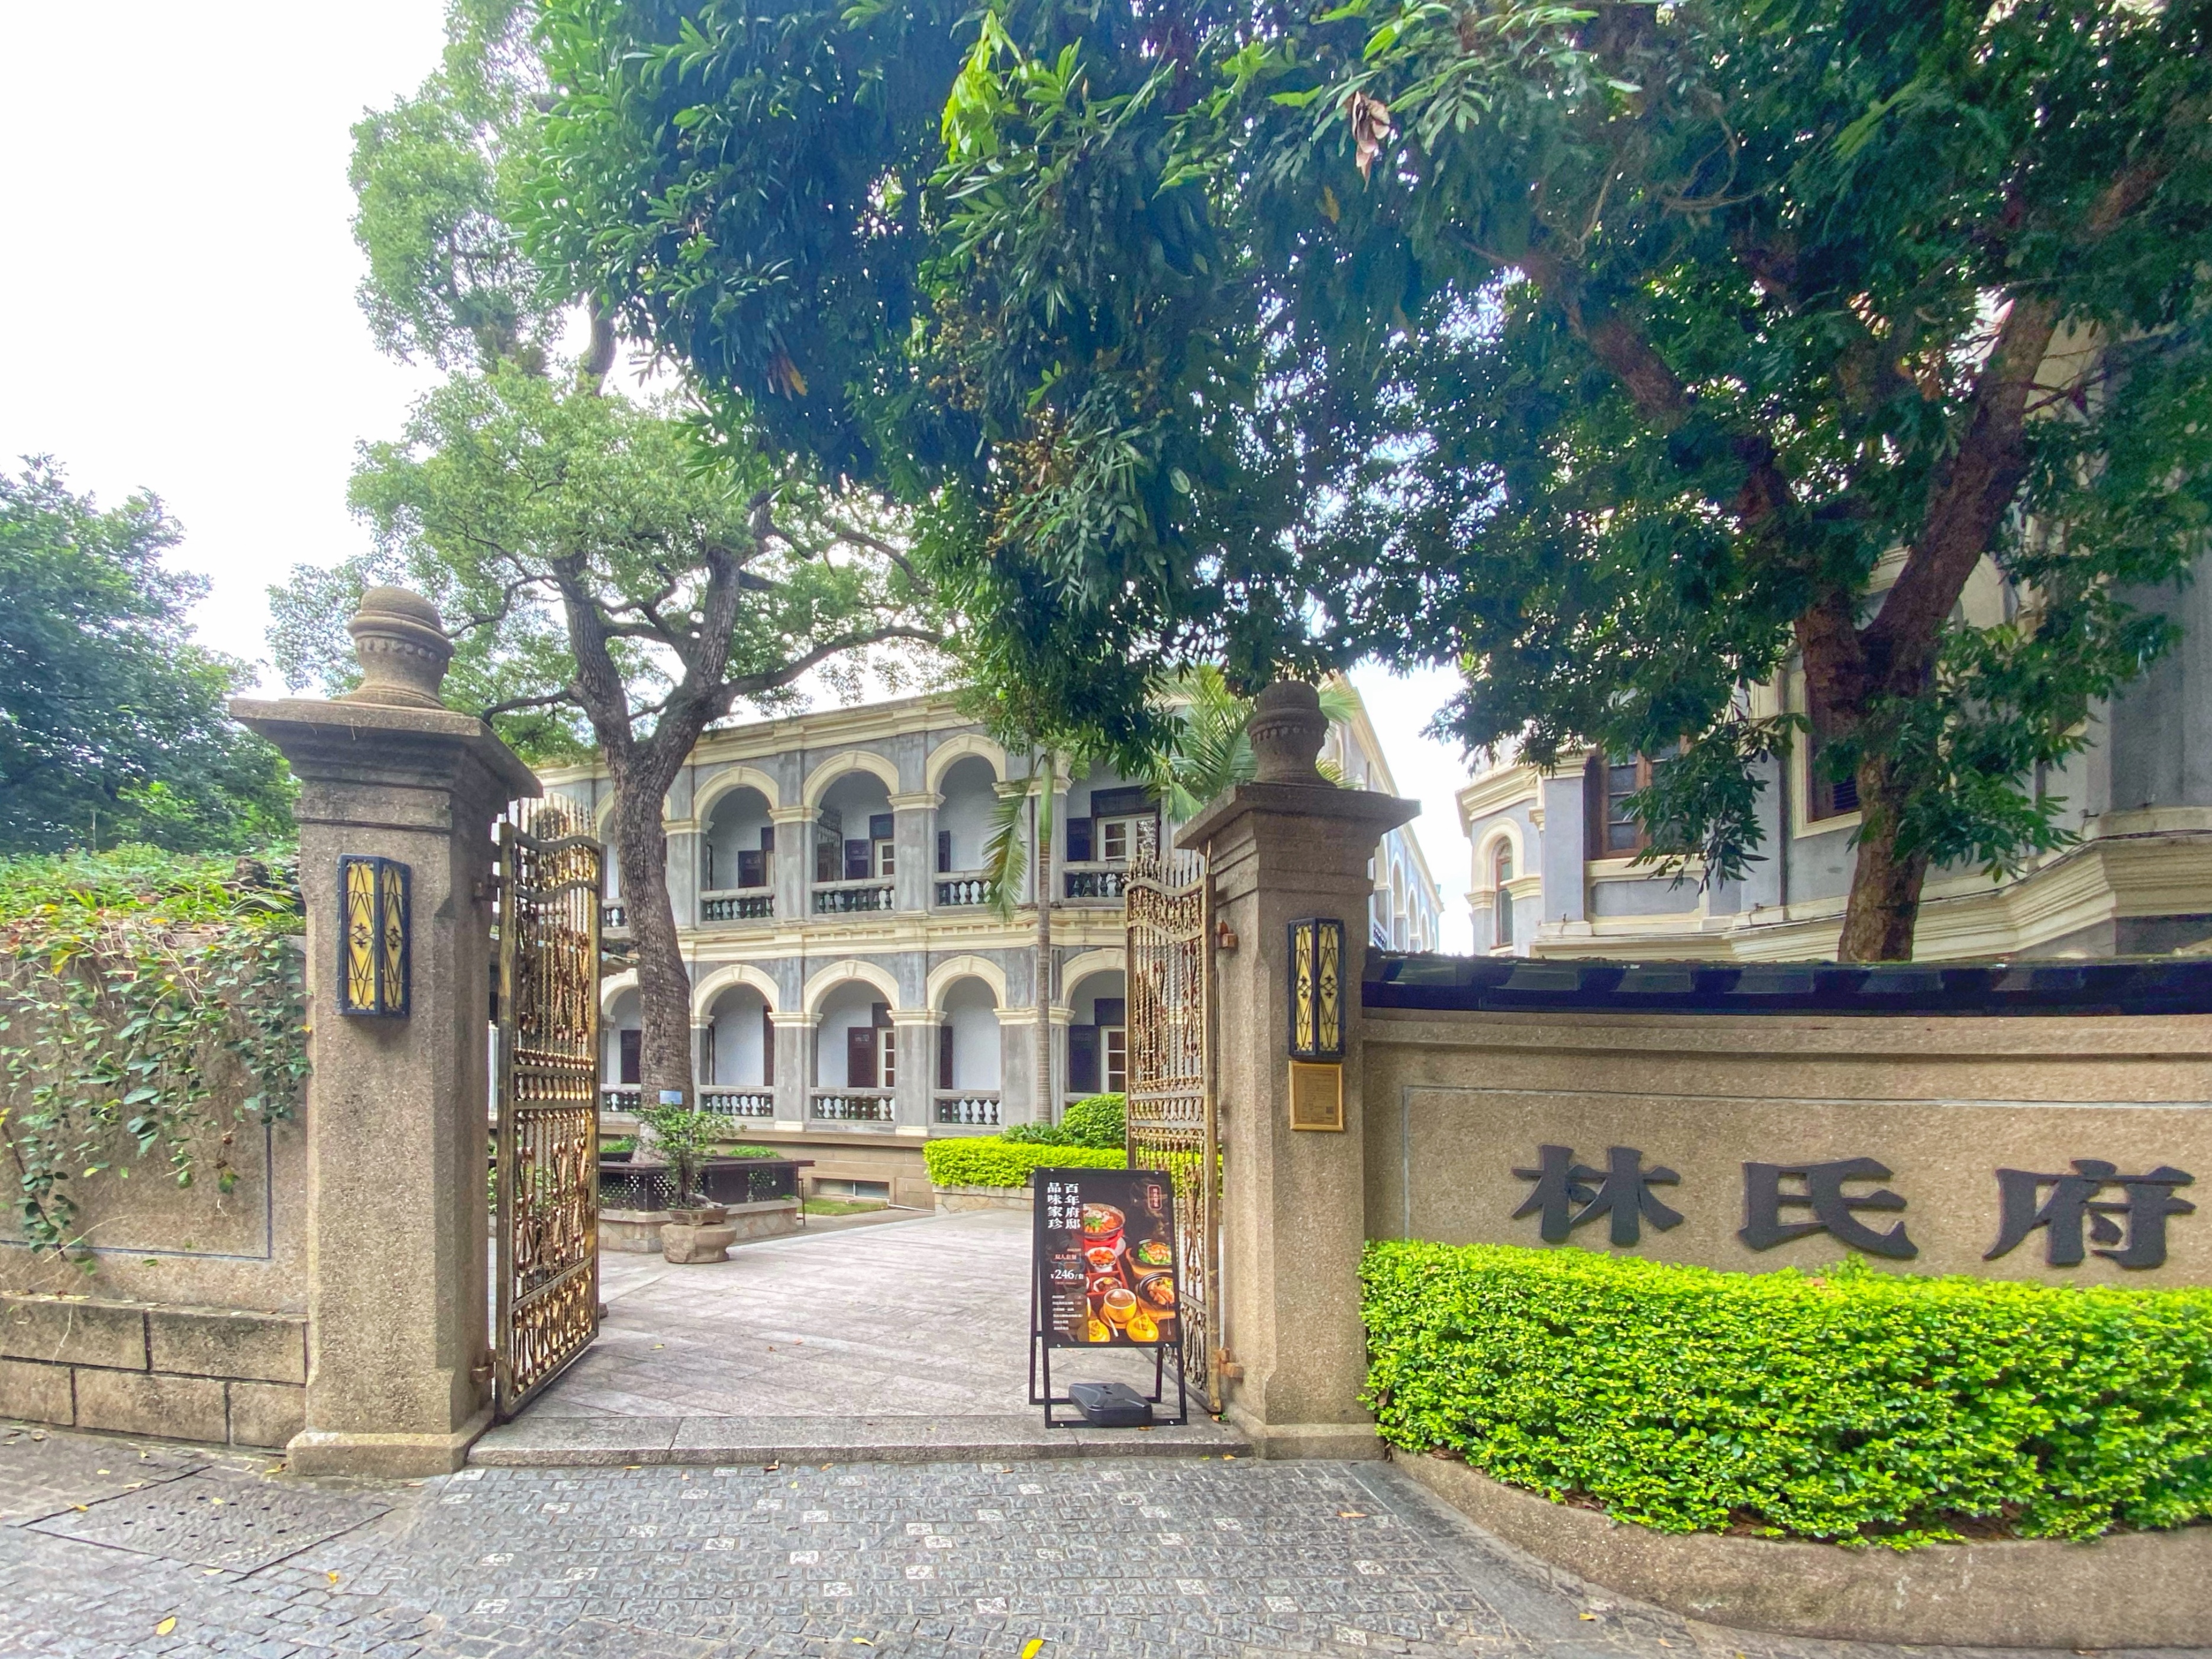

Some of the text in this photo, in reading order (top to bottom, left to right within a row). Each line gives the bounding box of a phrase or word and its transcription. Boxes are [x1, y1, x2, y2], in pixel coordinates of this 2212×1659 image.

[1047, 1182, 1063, 1229] 品味家珍
[1064, 1183, 1080, 1229] 百年府邸
[1511, 1145, 2195, 1269] 林氏府
